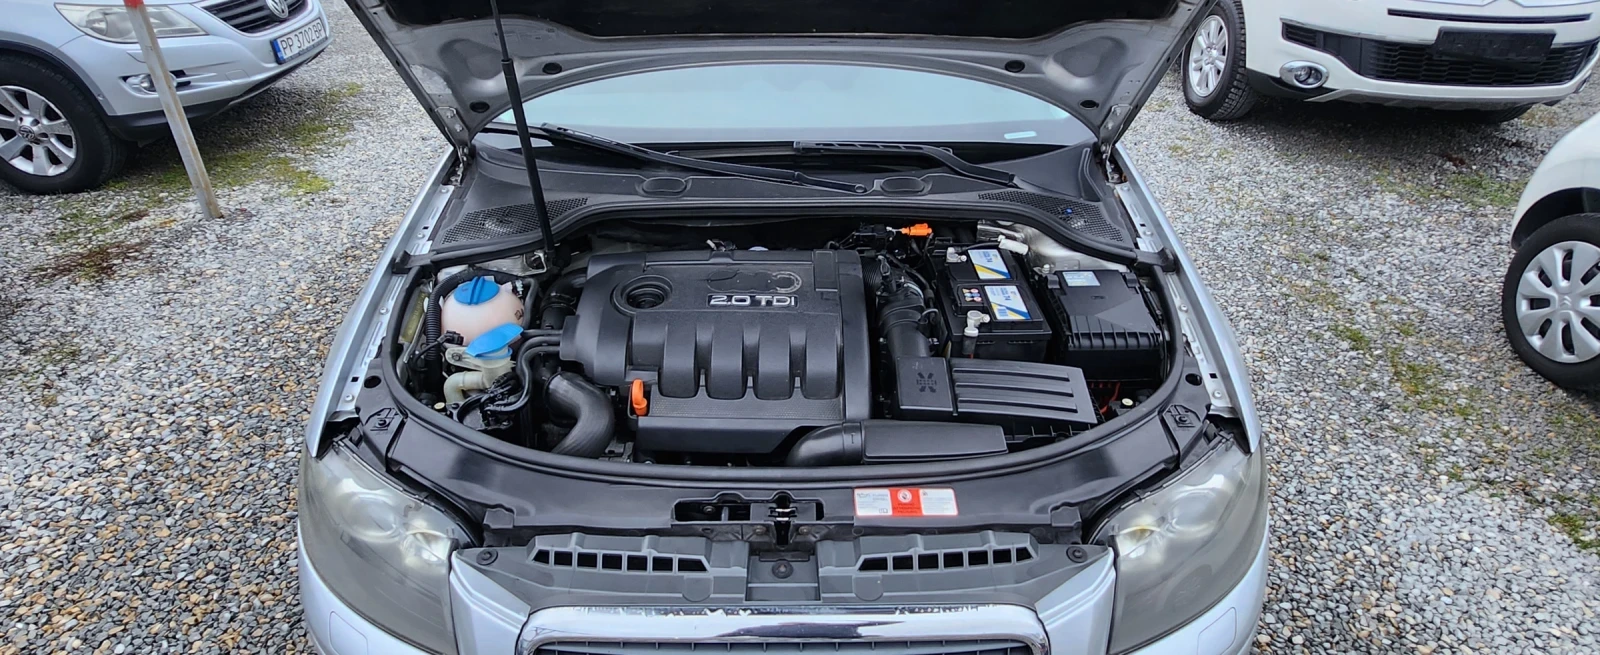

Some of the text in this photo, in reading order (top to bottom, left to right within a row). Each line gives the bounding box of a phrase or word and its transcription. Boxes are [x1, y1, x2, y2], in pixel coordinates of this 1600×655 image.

[280, 22, 323, 56] PP 3702 BP
[710, 295, 795, 306] 2.0 TDI
